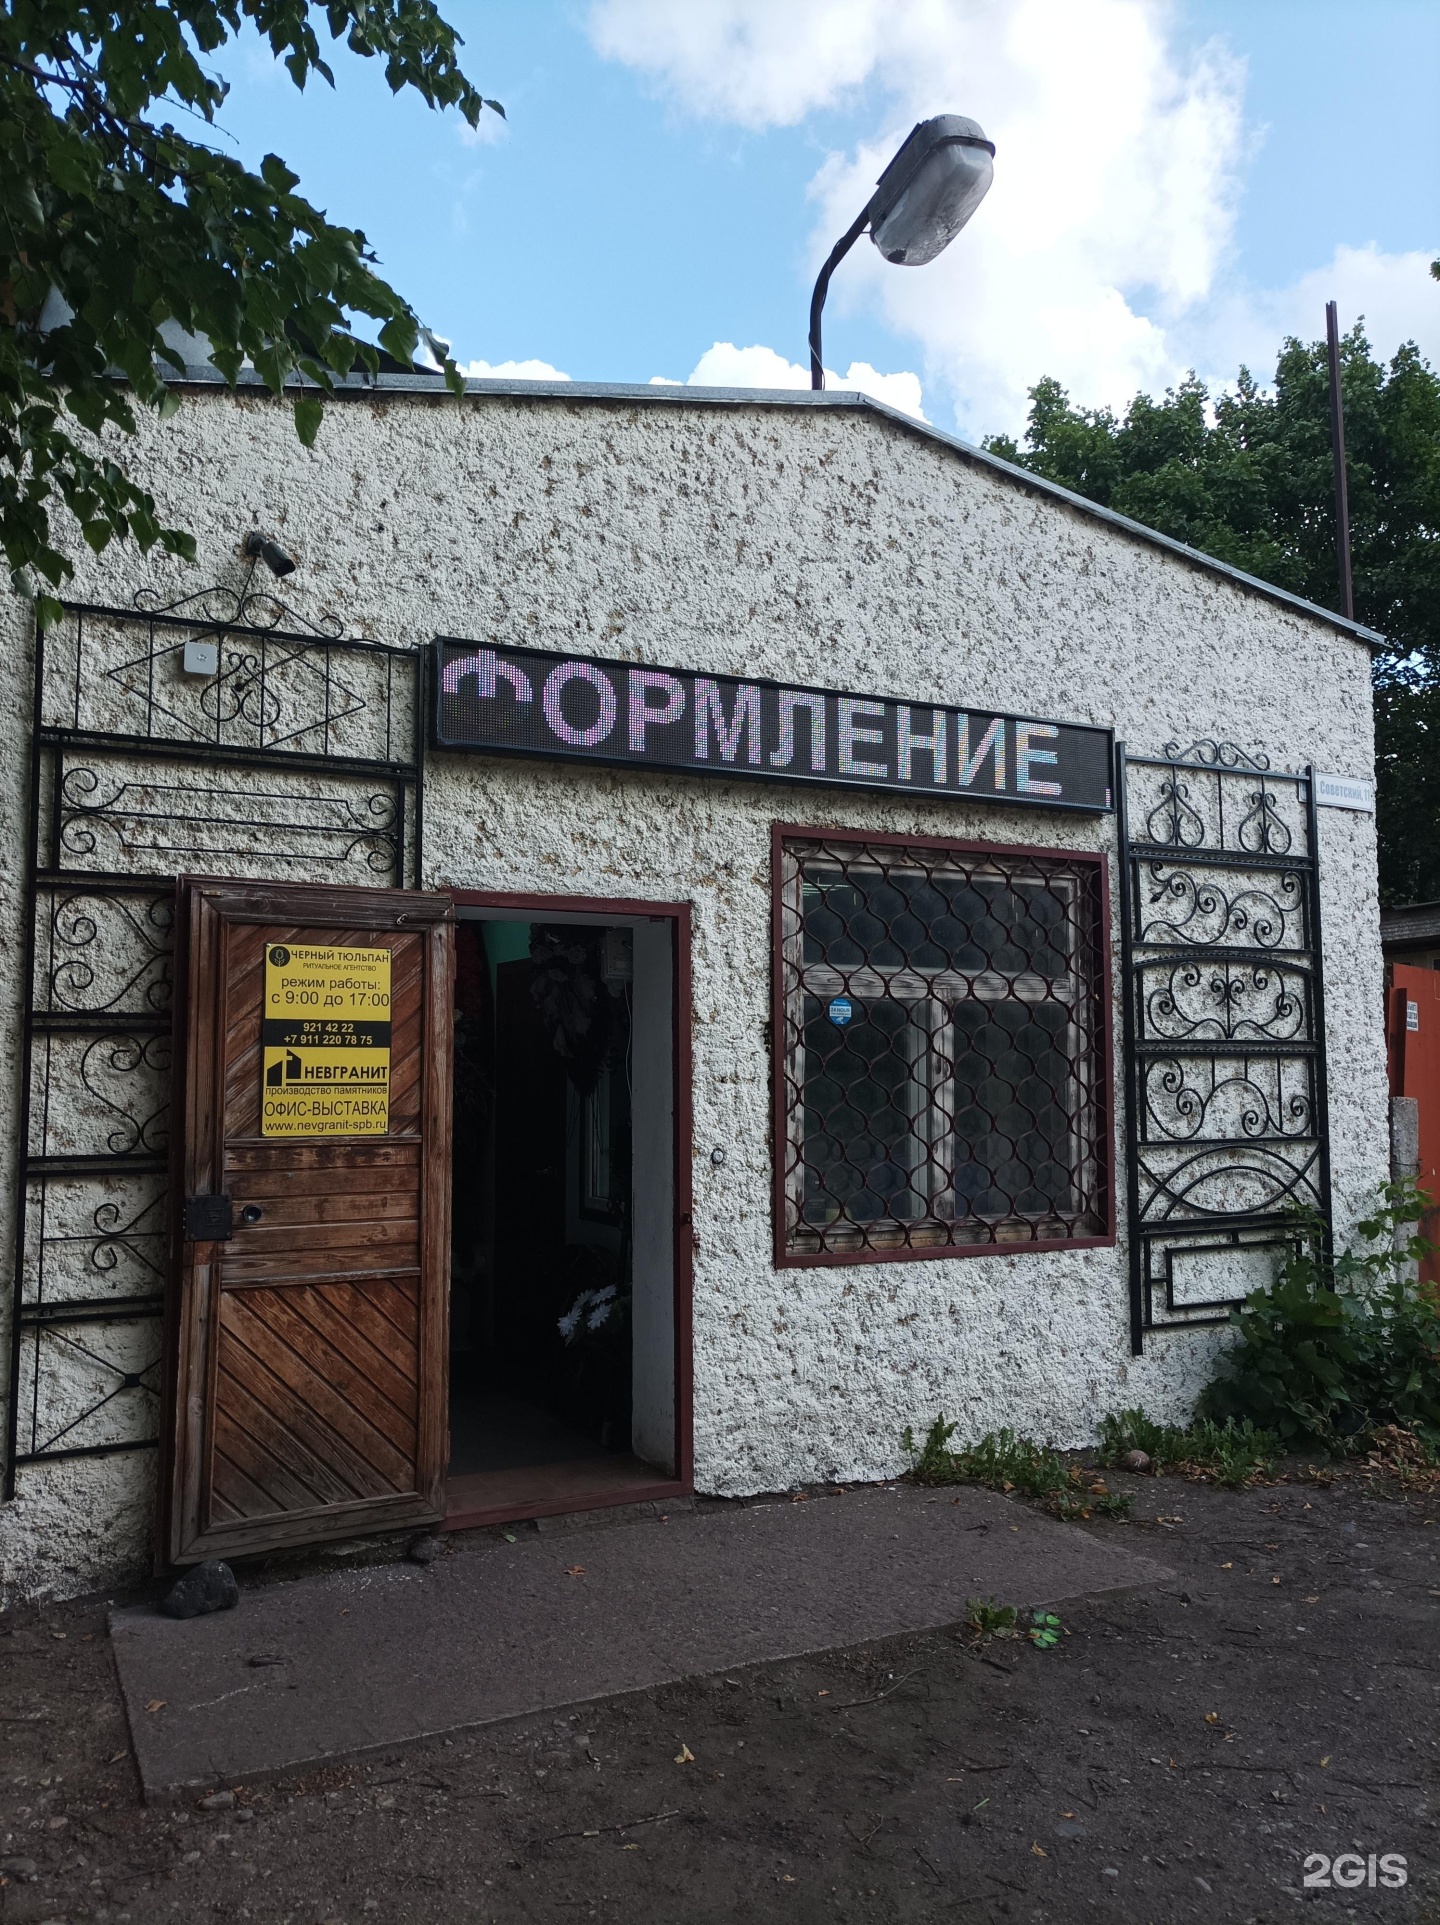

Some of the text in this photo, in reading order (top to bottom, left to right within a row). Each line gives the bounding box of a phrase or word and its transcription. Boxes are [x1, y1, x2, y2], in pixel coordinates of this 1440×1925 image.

[1320, 780, 1363, 802] Советский,
[291, 950, 389, 962] ЧЕРНЫЙ ТЮЛЬПАН
[281, 978, 381, 991] режим работы:
[271, 990, 390, 1007] с 9:00 до 17:00
[303, 1022, 354, 1033] 921 42 22
[284, 1035, 373, 1045] +7 911 220 78 75
[304, 1066, 388, 1079] НЕВГРАНИТ
[265, 1086, 388, 1097] производство памятников
[264, 1101, 387, 1117] ОФИС-ВЫСТАВКА
[265, 1119, 386, 1132] www.nevgranit-spb.ru
